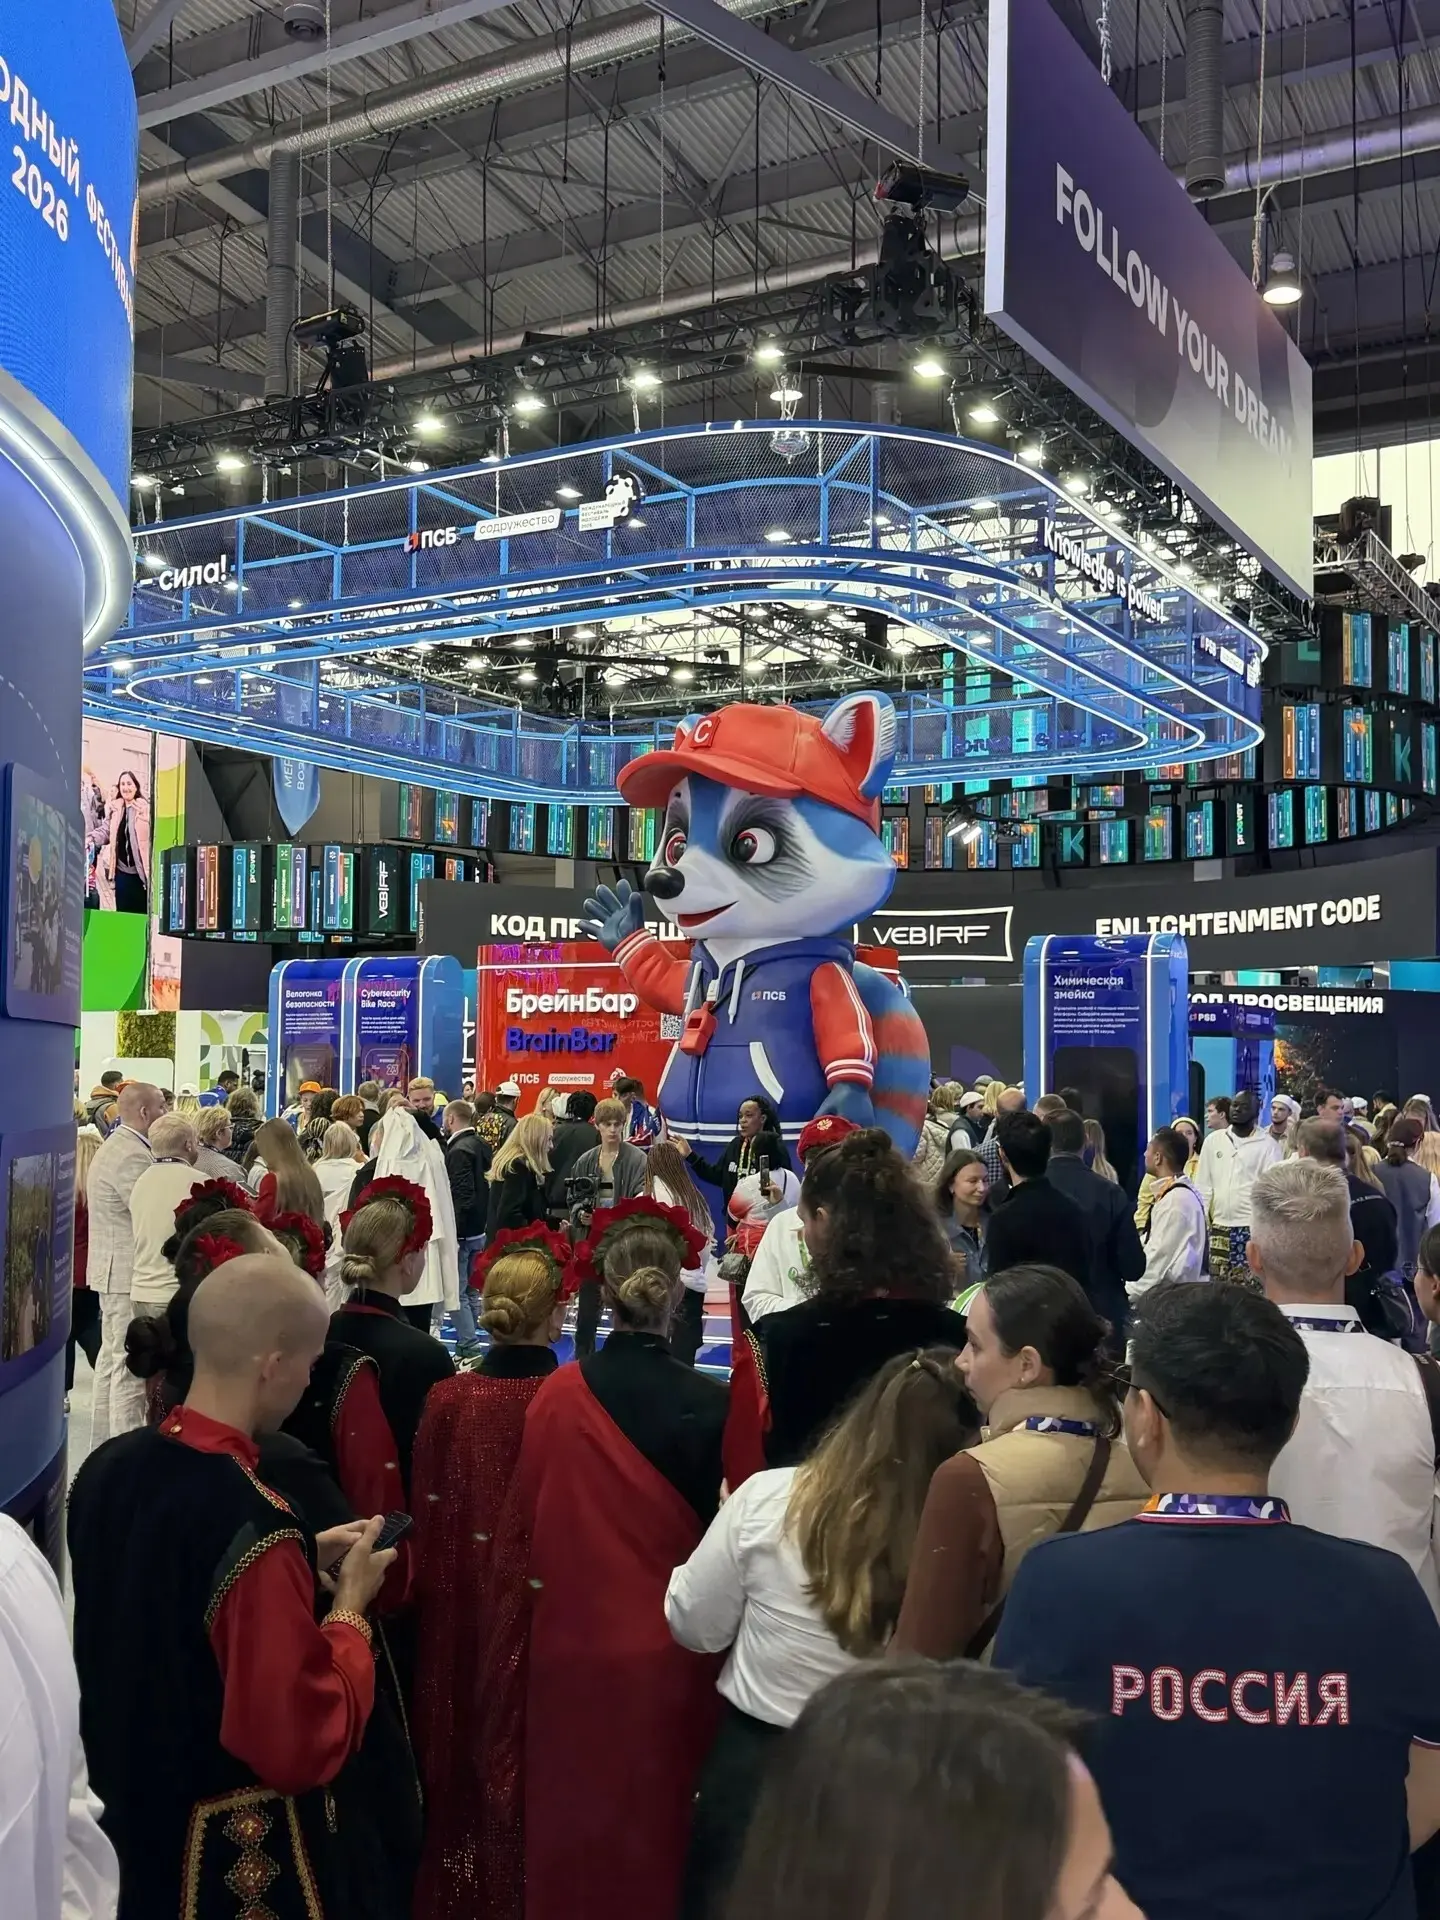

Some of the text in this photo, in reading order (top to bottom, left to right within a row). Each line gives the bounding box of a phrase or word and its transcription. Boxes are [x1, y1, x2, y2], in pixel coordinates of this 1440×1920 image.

[11, 145, 68, 242] 2026
[1056, 162, 1168, 337] FOLLOW
[1173, 297, 1229, 408] YOUR
[479, 514, 555, 534] содружество
[421, 527, 457, 549] ПСБ
[1044, 517, 1114, 591] Knowledge
[1117, 575, 1126, 598] is
[159, 554, 227, 591] сила!
[1321, 894, 1380, 926] CODE
[491, 915, 546, 941] КОД
[872, 924, 990, 947] VEB|RF
[1054, 974, 1124, 986] Химическая
[285, 1000, 335, 1009] безопасности
[286, 990, 322, 998] Велогонка
[361, 989, 411, 999] Cybersecurity
[361, 1000, 396, 1008] Bike Race
[506, 987, 639, 1019] БрейнБар
[762, 991, 786, 1001] ПСБ
[1054, 989, 1095, 1000] змейка
[1198, 1013, 1216, 1022] PSB
[506, 1025, 617, 1051] BrainBar
[519, 1073, 540, 1084] ПСБ
[1111, 1664, 1350, 1726] РОССИЯ
